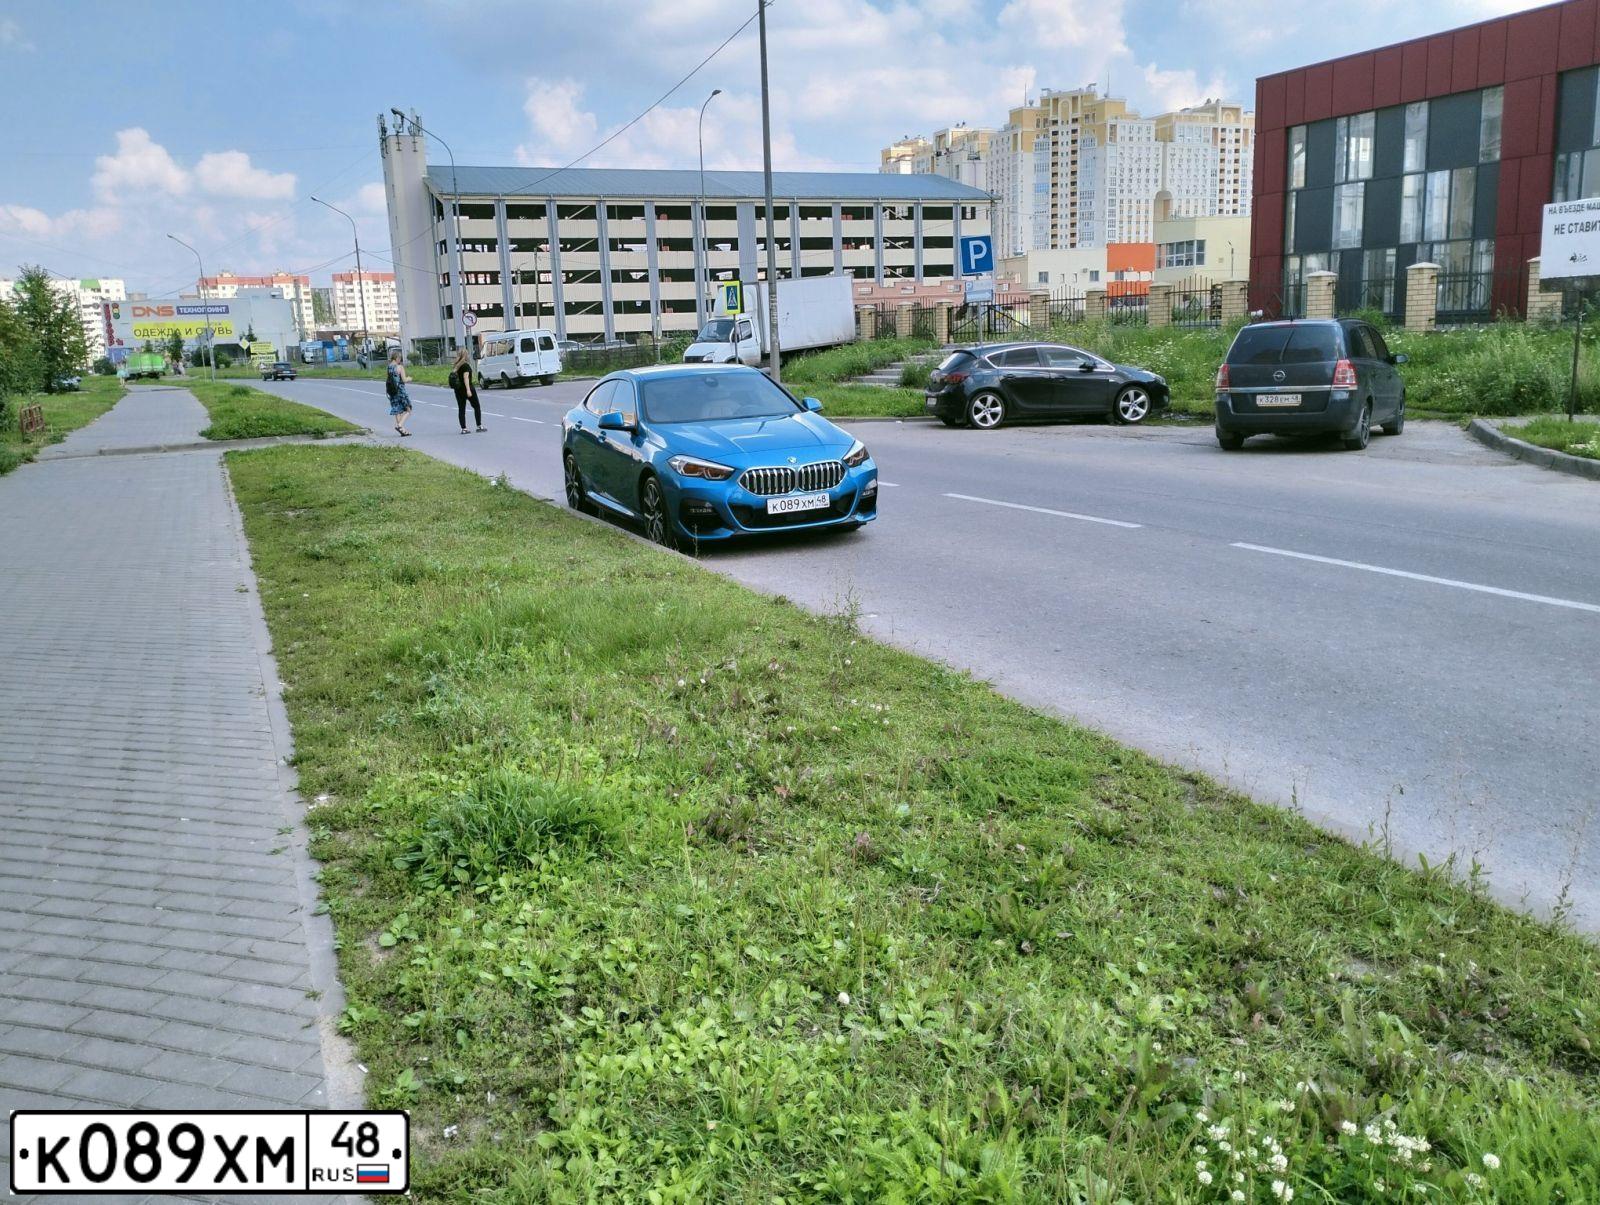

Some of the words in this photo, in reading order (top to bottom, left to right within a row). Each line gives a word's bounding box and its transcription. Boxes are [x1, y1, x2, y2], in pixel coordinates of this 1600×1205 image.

[1548, 206, 1558, 215] НА
[1559, 203, 1585, 214] ВЪЕЗДЕ
[1554, 223, 1566, 235] НЕ
[968, 240, 987, 269] P
[132, 306, 175, 317] DNS
[133, 328, 181, 338] ОДЕЖДА
[185, 327, 193, 336] И
